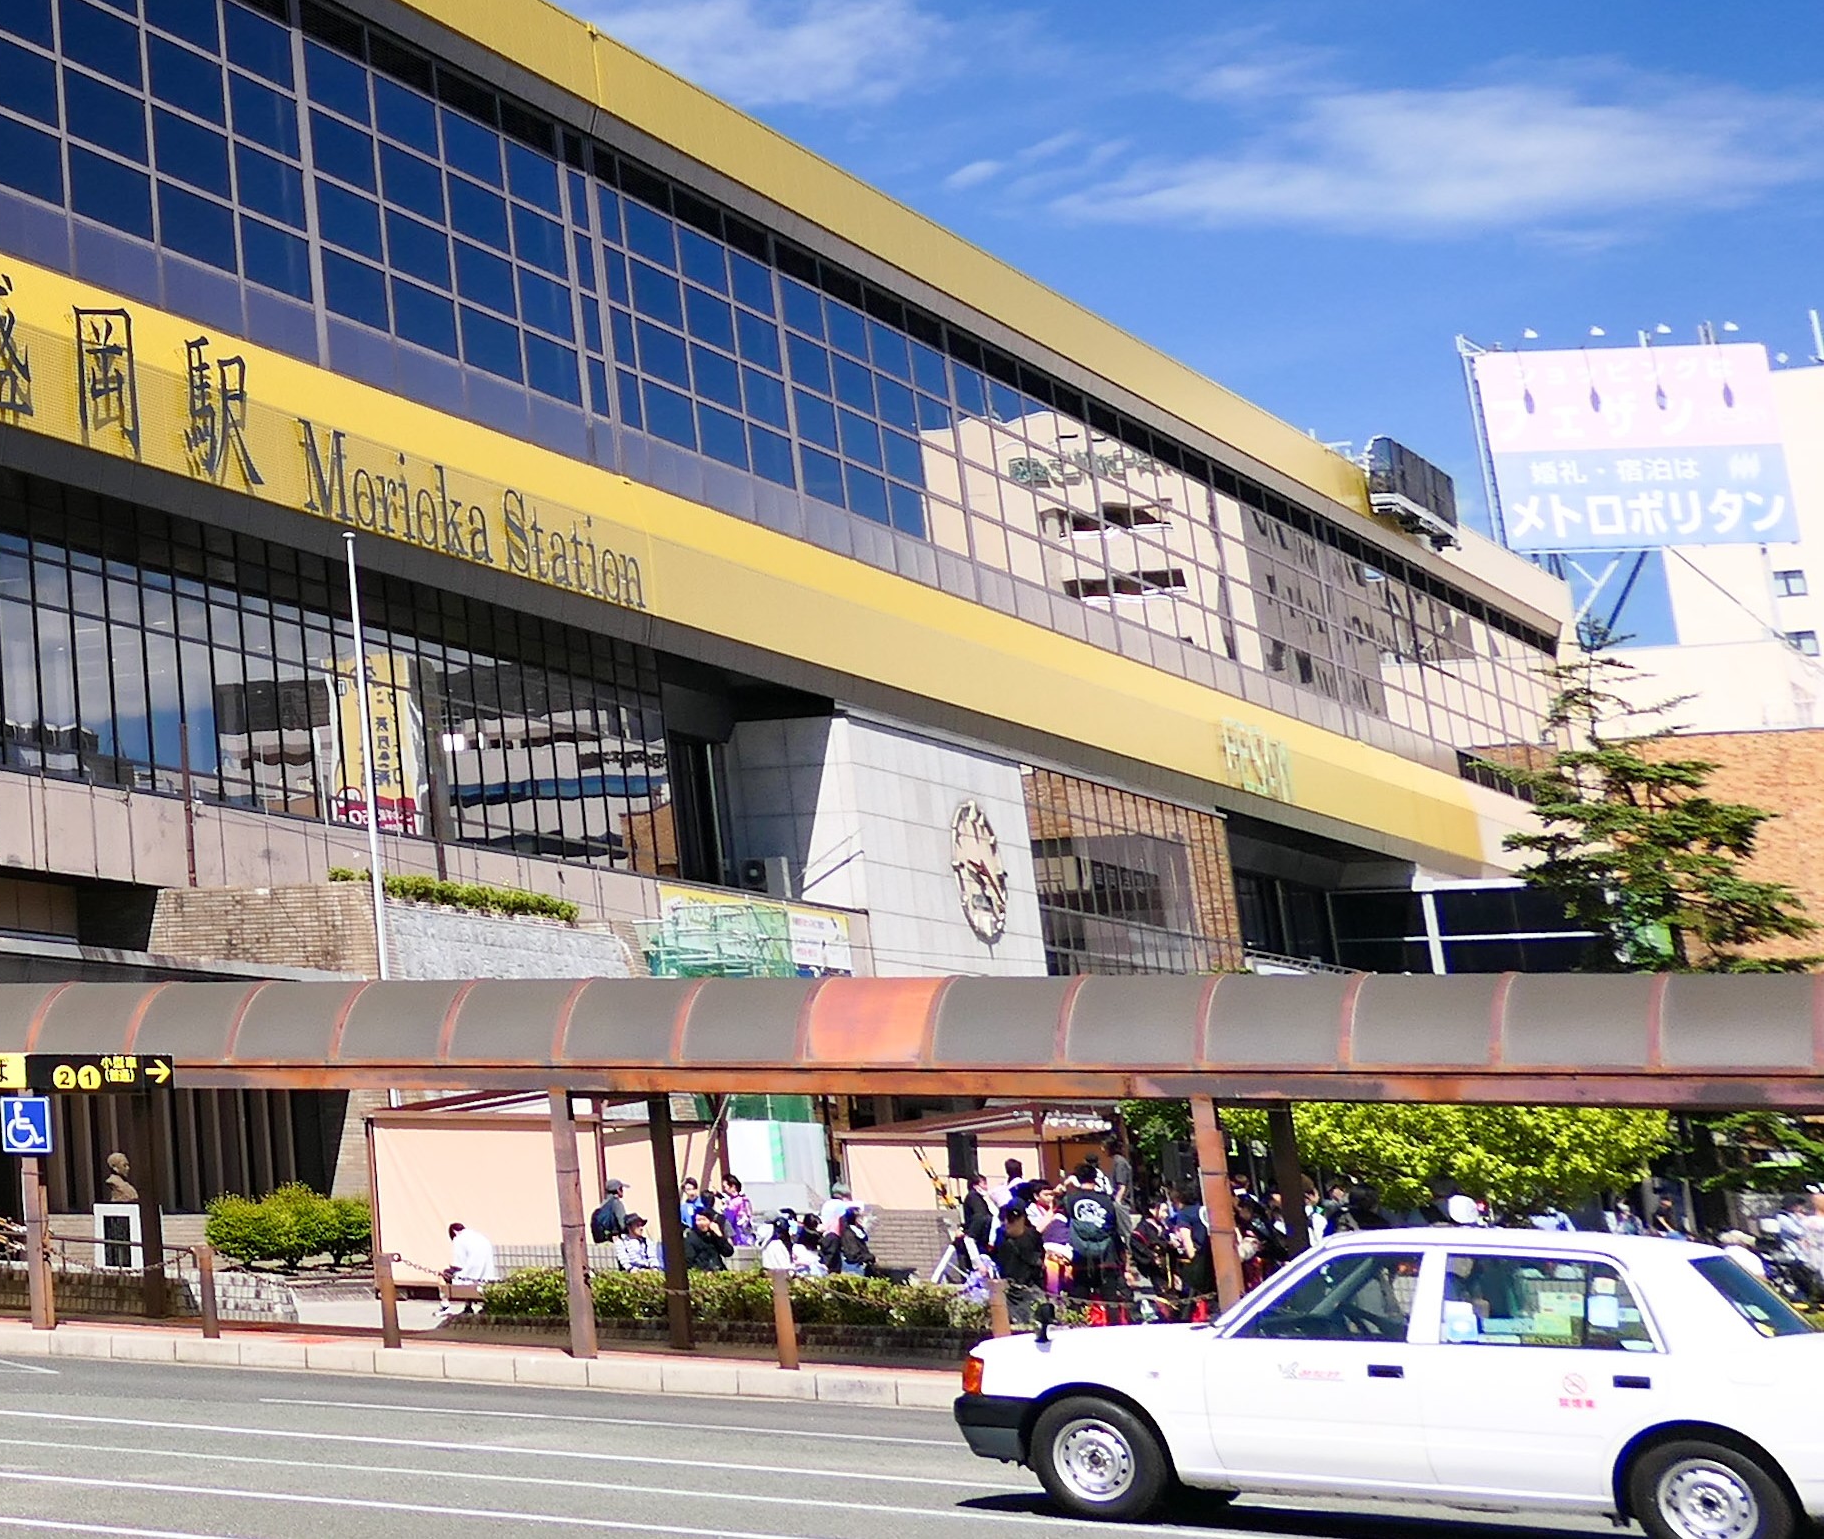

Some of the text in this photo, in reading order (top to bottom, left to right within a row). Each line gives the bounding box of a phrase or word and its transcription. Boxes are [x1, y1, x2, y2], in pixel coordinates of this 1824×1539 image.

[1512, 355, 1735, 387] ショッピングは
[1491, 390, 1696, 445] フェザン
[1528, 456, 1703, 486] 婚礼・宿泊は
[298, 415, 648, 612] Morioka Station
[1511, 489, 1787, 540] メトロポリタン
